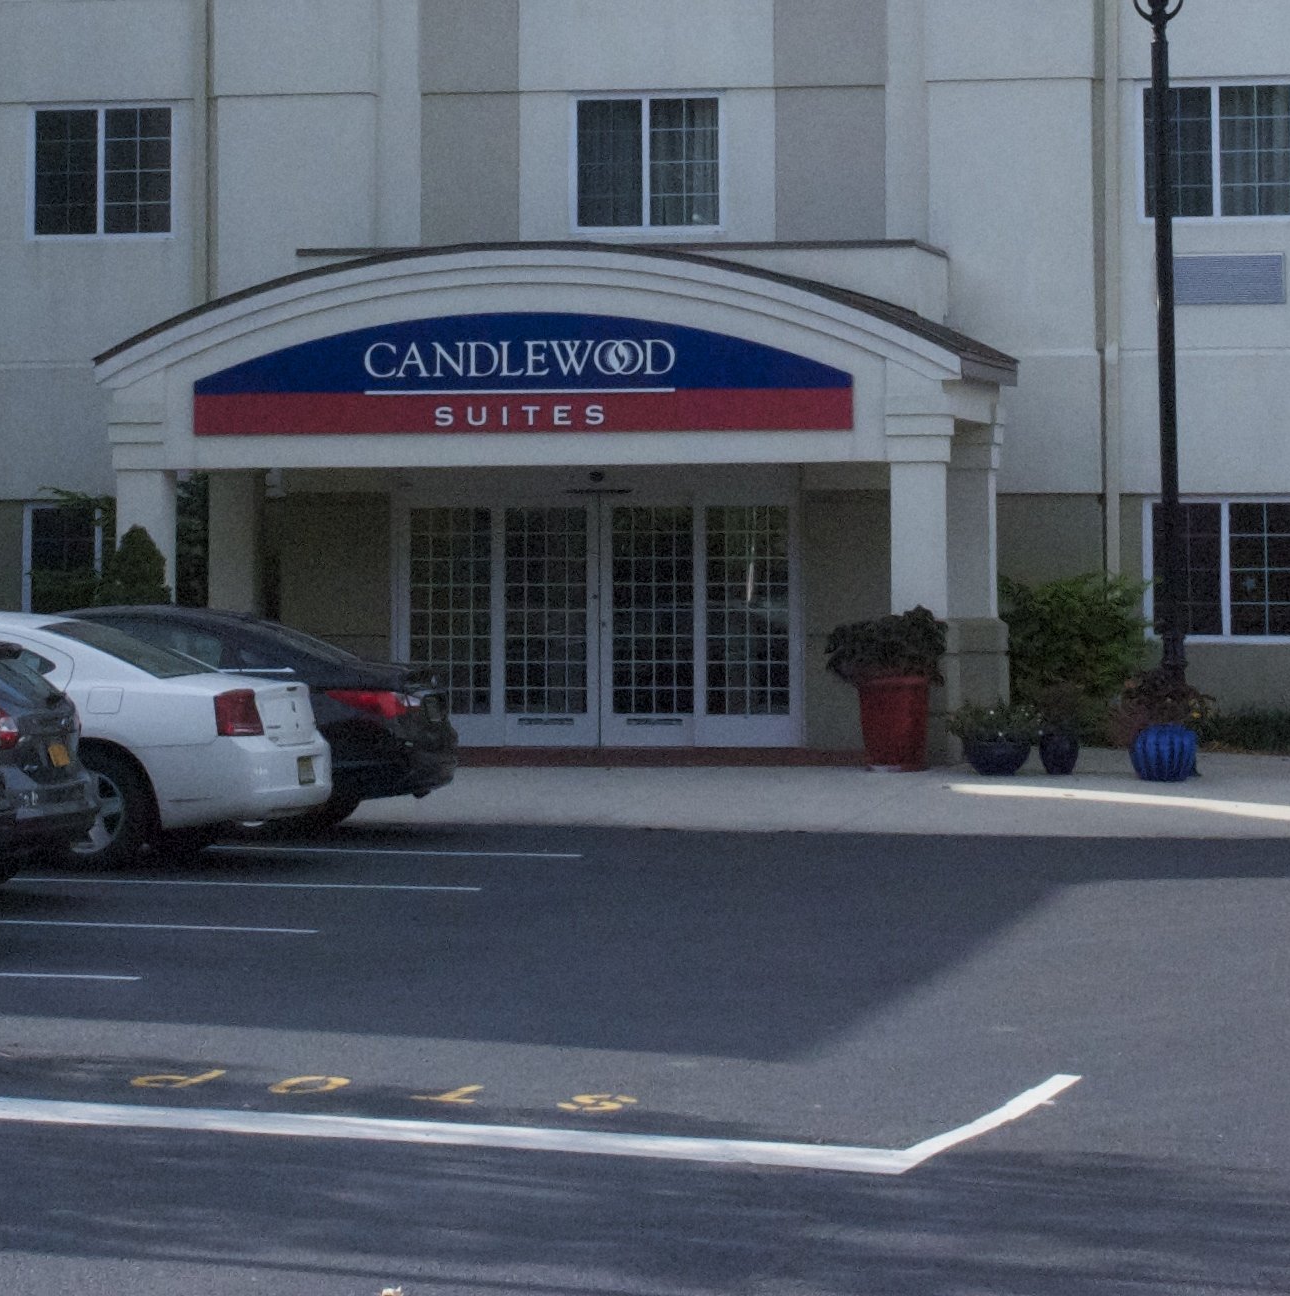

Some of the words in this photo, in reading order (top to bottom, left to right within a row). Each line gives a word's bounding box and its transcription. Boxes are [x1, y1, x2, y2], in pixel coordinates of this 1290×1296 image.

[364, 339, 675, 378] CANDLEWOOD
[435, 406, 605, 426] SUITES
[130, 1069, 638, 1111] STOP
